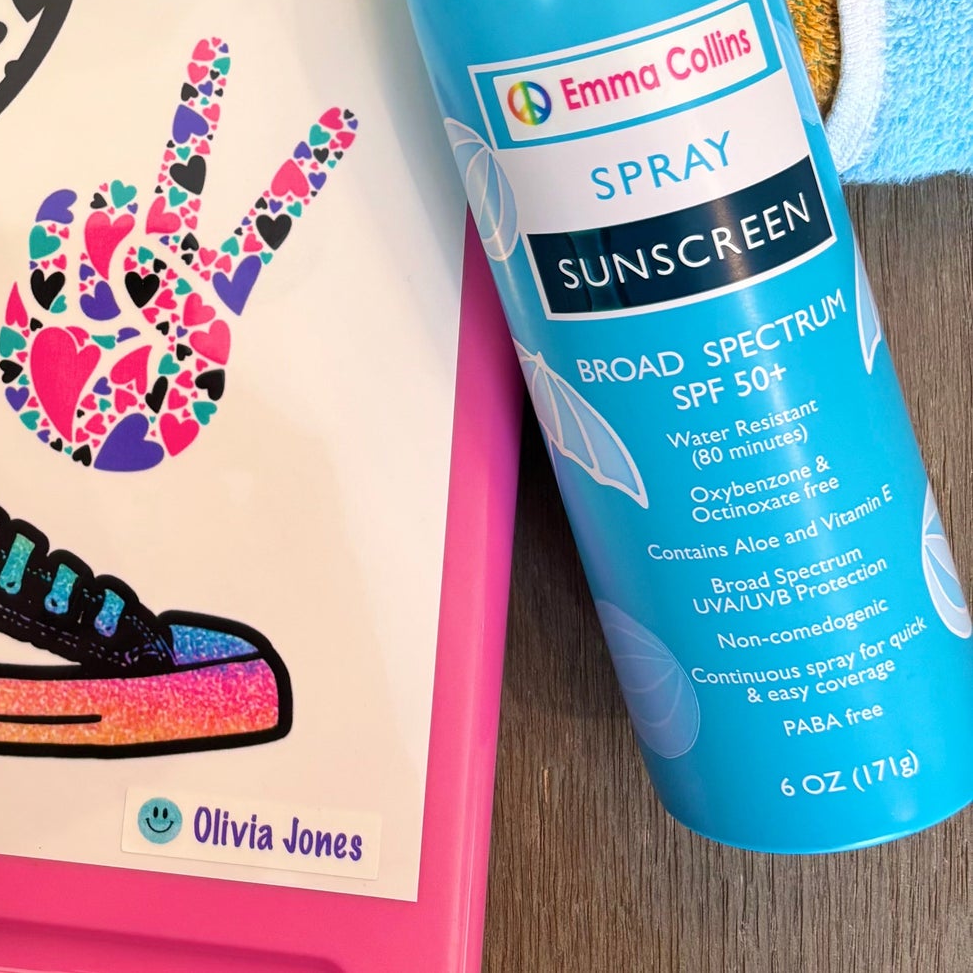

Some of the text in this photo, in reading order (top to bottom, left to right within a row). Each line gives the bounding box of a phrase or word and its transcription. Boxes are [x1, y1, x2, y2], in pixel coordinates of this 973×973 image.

[560, 28, 752, 110] Emma Collins
[590, 130, 730, 200] SPRAY
[558, 192, 810, 289] SUNSCREEN
[576, 288, 846, 383] BROAD SPECTRUM
[672, 362, 787, 411] SPF 50+
[666, 399, 819, 448] Water Resistant
[692, 423, 808, 470] (80 minutes)
[690, 454, 831, 504] Oxybenzone &
[692, 476, 840, 523] Octinoxate free
[647, 484, 893, 561] Contains Aloe and Vitamin E
[692, 556, 887, 615] UVA/UVB Protection
[710, 546, 863, 595] Broad Spectrum
[717, 597, 889, 649] Non-comedogenic
[691, 615, 927, 685] Continuous spray for quick
[746, 659, 896, 704] & easy coverage
[784, 703, 883, 737] PABA free
[780, 749, 919, 796] 6 OZ (171g)
[193, 805, 363, 861] Olivia Jones
